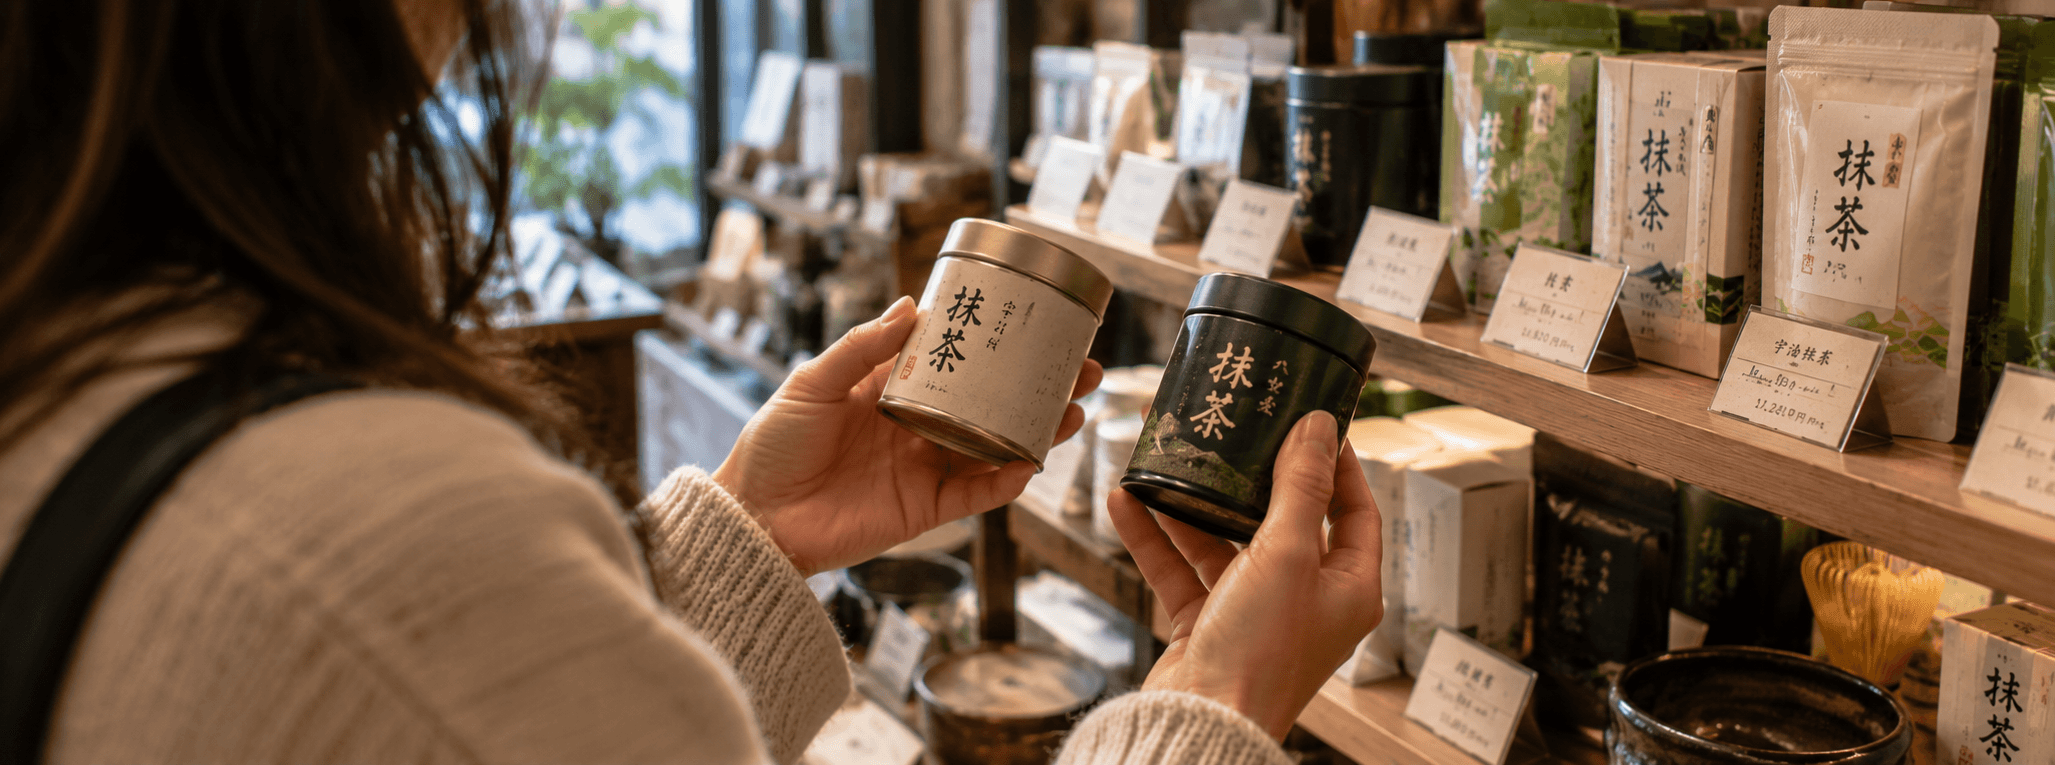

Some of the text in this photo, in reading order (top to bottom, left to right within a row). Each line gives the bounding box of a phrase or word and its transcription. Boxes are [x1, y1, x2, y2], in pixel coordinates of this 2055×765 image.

[1638, 128, 1672, 232] 抹茶
[1825, 139, 1876, 252] 抹茶
[928, 285, 985, 373] 抹茶
[1190, 342, 1255, 440] 抹茶
[1979, 667, 2023, 763] 抹茶
